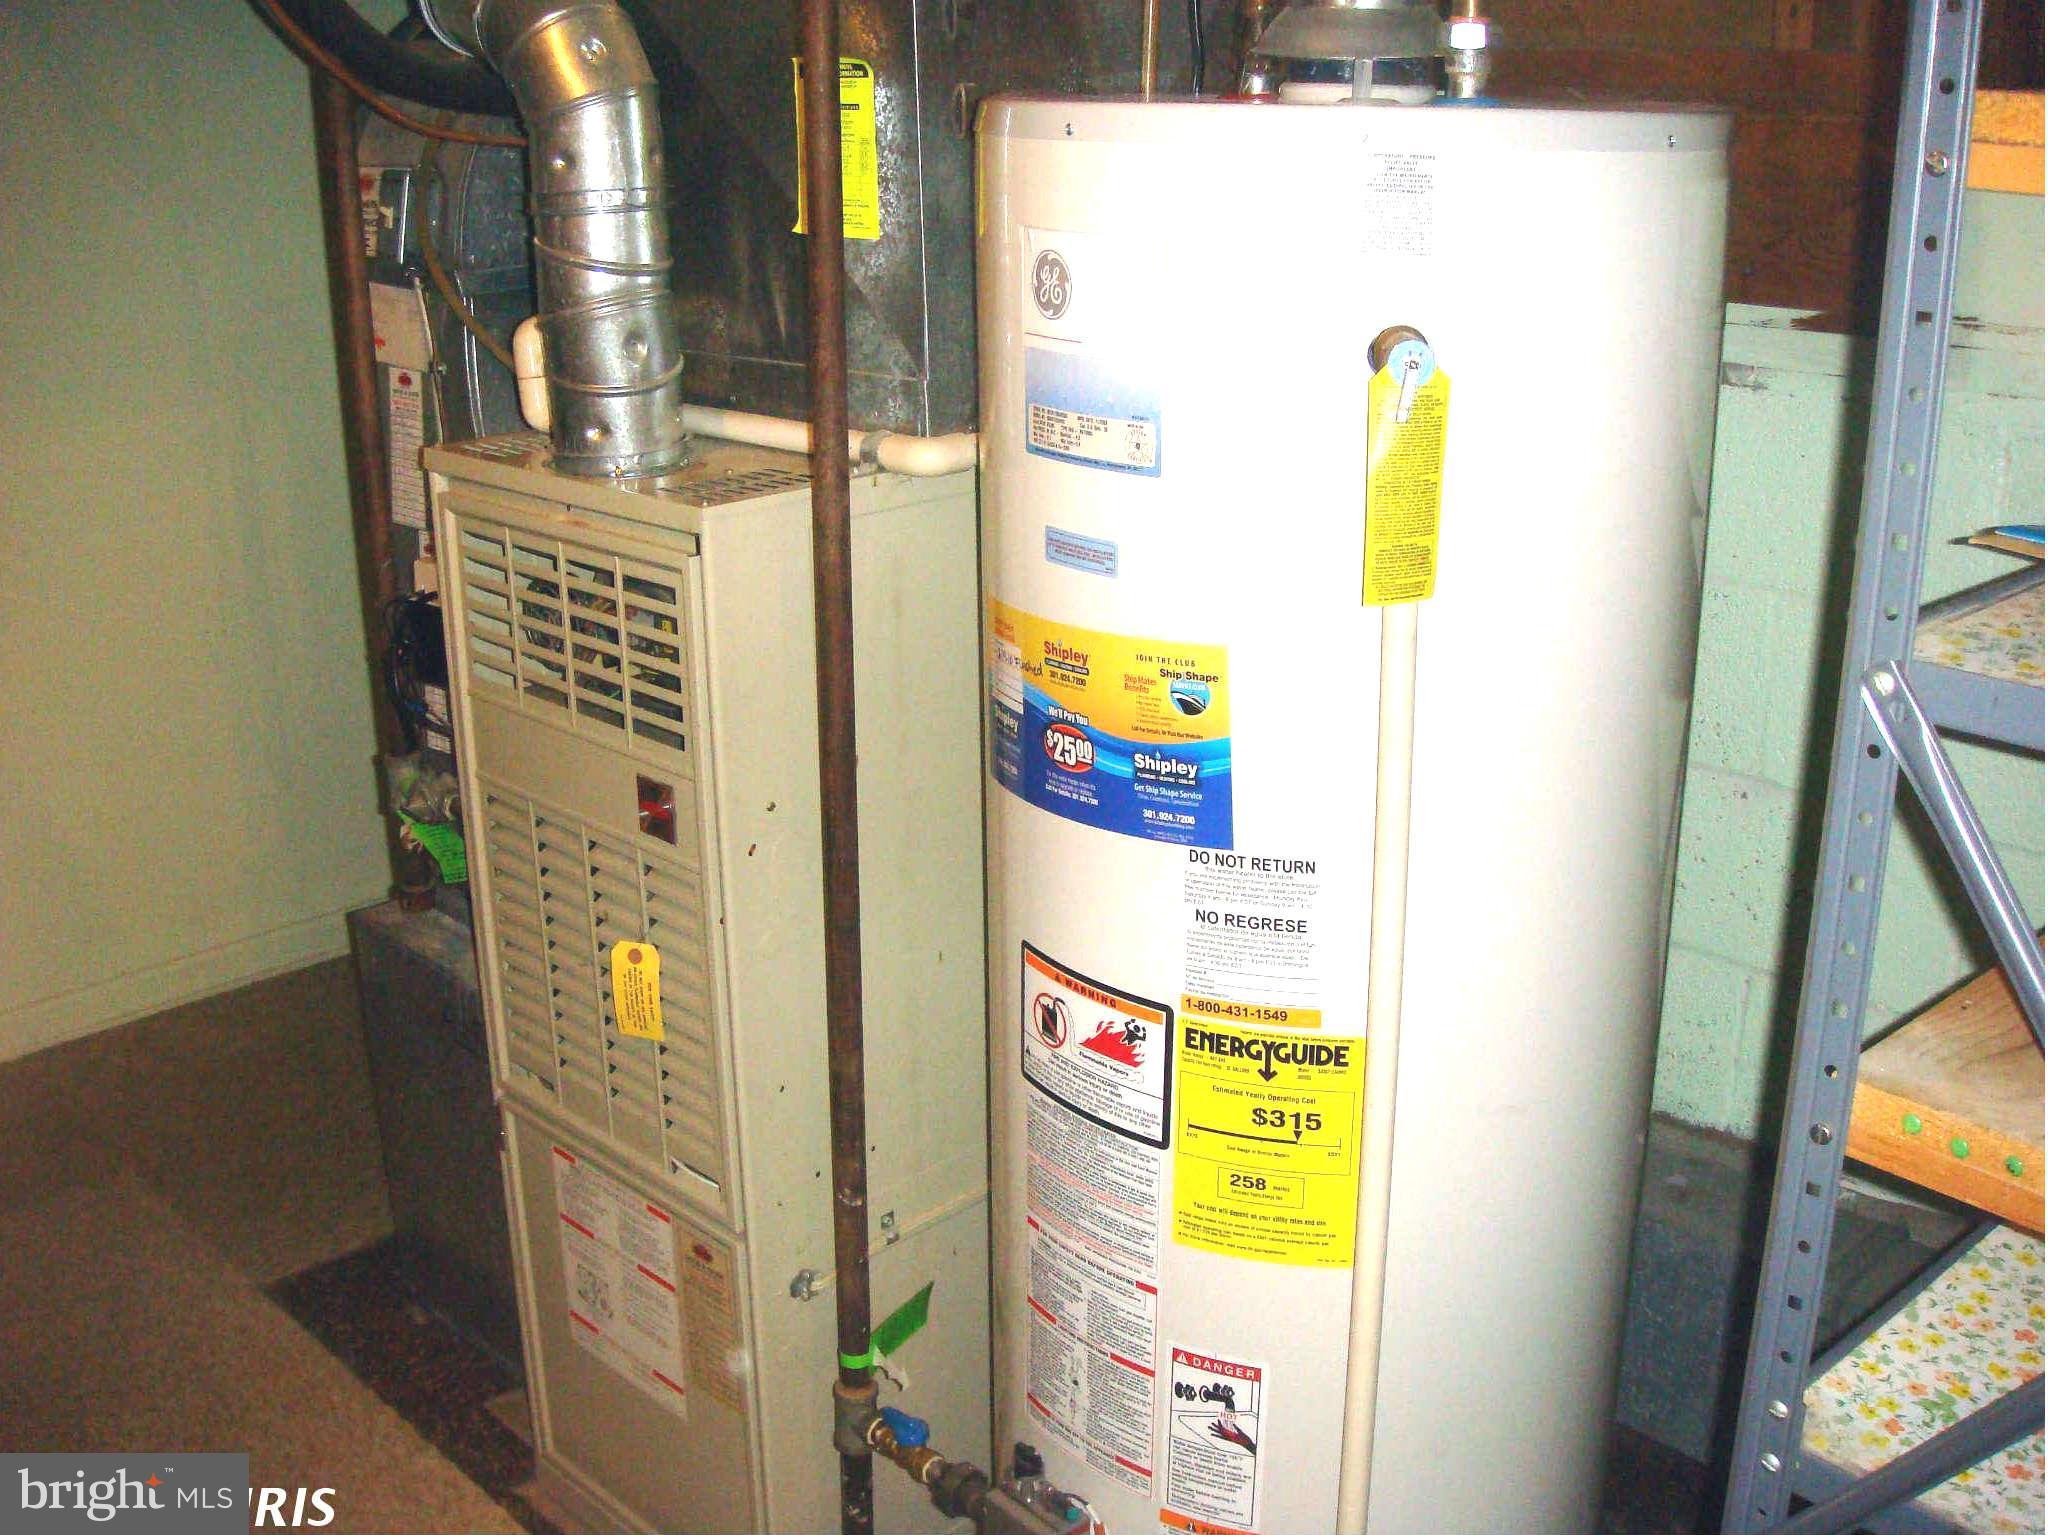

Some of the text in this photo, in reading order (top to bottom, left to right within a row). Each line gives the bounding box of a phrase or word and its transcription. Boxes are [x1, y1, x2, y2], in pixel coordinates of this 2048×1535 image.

[1044, 640, 1088, 666] Shipley
[1136, 654, 1196, 667] JOIN THE CLUB
[1160, 668, 1219, 683] Ship Shape
[1048, 705, 1089, 726] We'll Pay You
[1134, 753, 1198, 779] Shipley
[1134, 783, 1144, 791] Get
[1145, 784, 1159, 795] Ship
[1160, 787, 1179, 798] Shape
[1180, 790, 1203, 801] Service
[1142, 808, 1196, 825] 301.924.7200
[1189, 849, 1316, 874] DO NOT RETURN
[1195, 909, 1307, 933] NO REGRESE
[1065, 978, 1117, 1009] WARNING
[1185, 998, 1288, 1022] 1-800-431-1549
[1185, 1027, 1350, 1068] ENERGYGUIDE
[1212, 1085, 1316, 1105] Estimated Yearly Operating Cost
[1251, 1107, 1322, 1131] $315
[1229, 1173, 1267, 1191] 258
[1192, 1356, 1256, 1380] DANGER
[1220, 1411, 1237, 1420] HOT
